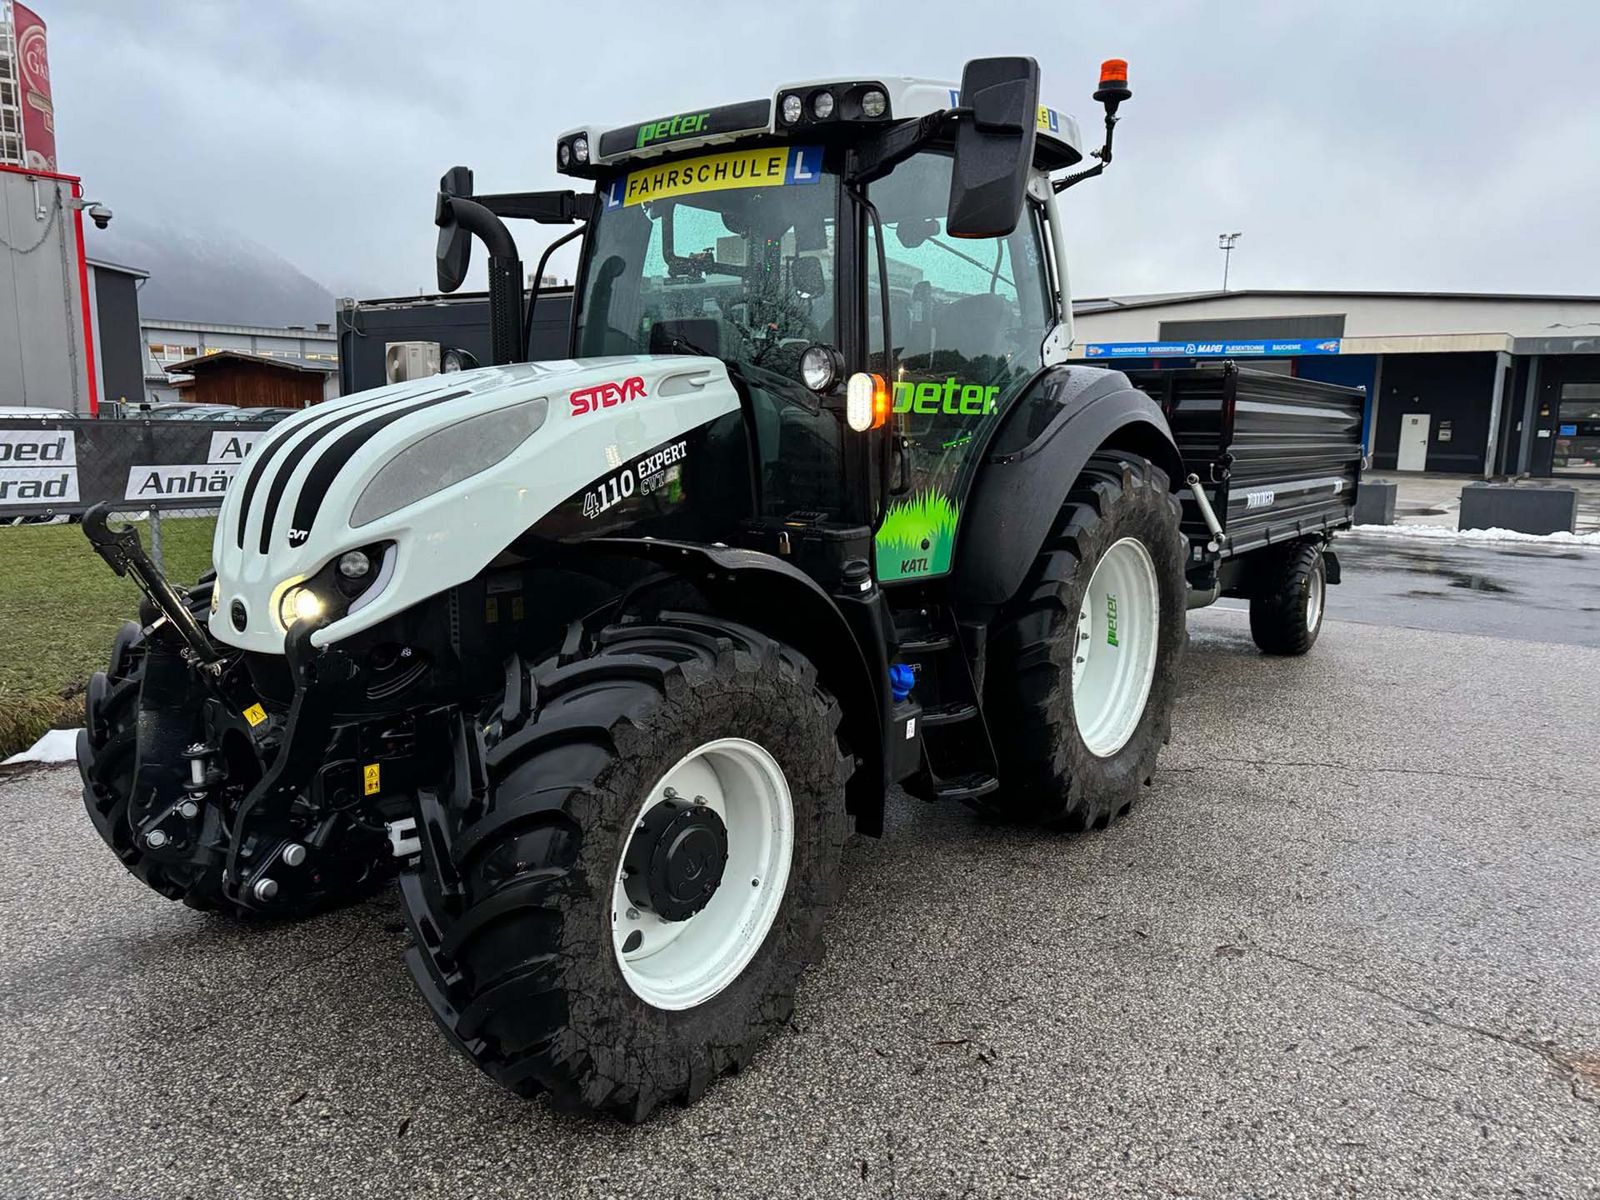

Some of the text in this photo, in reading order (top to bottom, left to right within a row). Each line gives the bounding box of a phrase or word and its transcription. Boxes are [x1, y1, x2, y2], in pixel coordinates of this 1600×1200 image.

[636, 112, 711, 149] peter.
[608, 151, 812, 207] L FAHRSCHULE L
[569, 376, 648, 416] STEYR
[637, 441, 687, 479] EXPERT
[138, 470, 233, 495] Anhä
[582, 469, 635, 519] 4110
[640, 470, 665, 496] CVT
[287, 528, 309, 540] CVT
